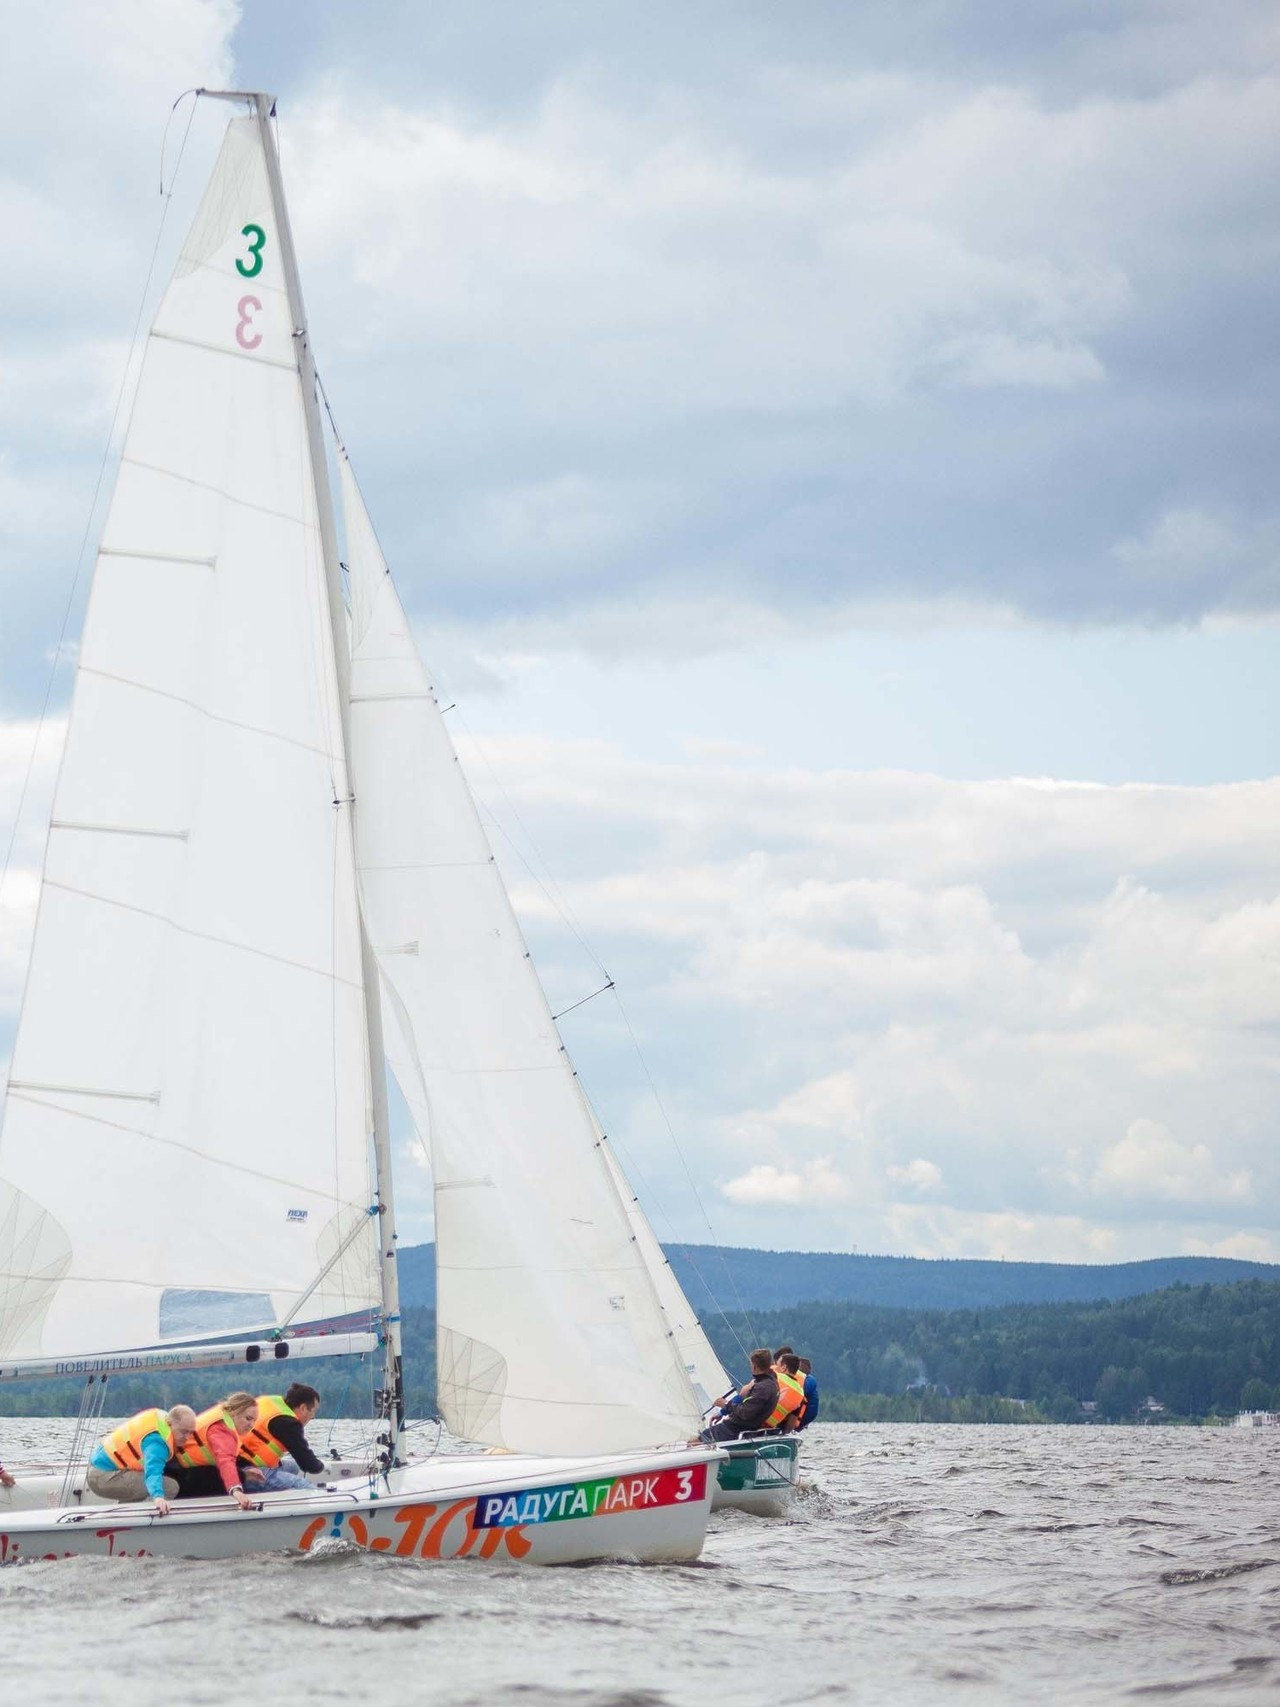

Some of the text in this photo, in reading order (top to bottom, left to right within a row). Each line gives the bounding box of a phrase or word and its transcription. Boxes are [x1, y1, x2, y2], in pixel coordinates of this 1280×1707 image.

[235, 223, 267, 279] 3
[55, 1357, 142, 1374] ПОВЕЛИТЕЛЬ
[145, 1353, 193, 1366] ПАРУСА
[483, 1470, 693, 1524] РАДУГА ПАРК 3
